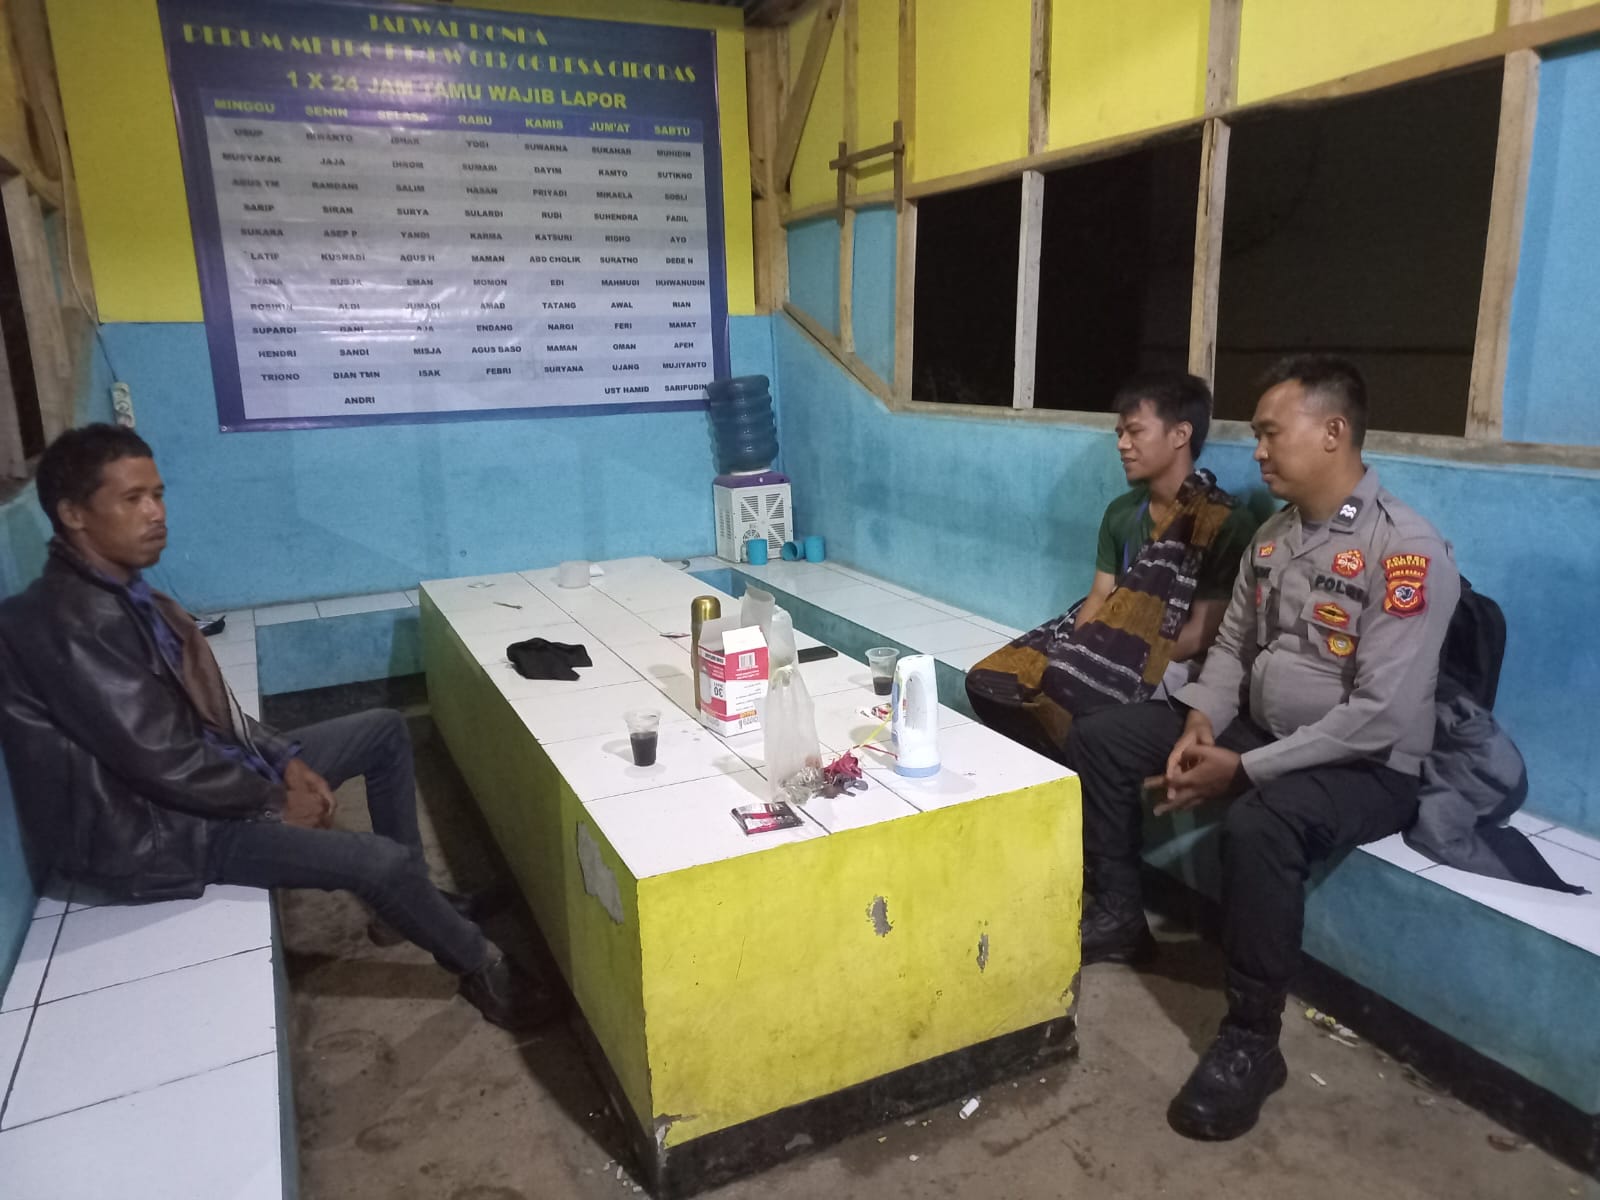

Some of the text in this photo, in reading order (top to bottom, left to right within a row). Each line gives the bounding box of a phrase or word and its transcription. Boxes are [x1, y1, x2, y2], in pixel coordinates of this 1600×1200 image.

[367, 13, 549, 46] JADWAL RONDA
[183, 24, 284, 51] PERUM
[549, 55, 604, 77] DESA
[287, 70, 627, 109] 1 X 24 JAM TAMU WAJIB LAPOR
[214, 99, 276, 113] MINGGU
[305, 105, 348, 118] SENIN
[458, 114, 492, 126] RABU
[525, 118, 564, 129] KAMIS
[590, 122, 631, 134] JUM'AT
[654, 125, 690, 137] SABTU
[524, 143, 568, 153] SUWARNA
[320, 157, 346, 167] JAJA
[657, 171, 693, 180] SUTIKNO
[396, 207, 430, 217] SURYA
[594, 213, 639, 222] SUHENDRA
[323, 230, 350, 238] ASEP
[400, 254, 427, 263] AGUS
[471, 255, 506, 263] MAMAN
[600, 257, 639, 265] SURATNO
[406, 279, 435, 287] EMAN
[473, 279, 509, 287] MOMON
[550, 279, 565, 287] EDI
[601, 279, 640, 287] MAHMUDI
[405, 302, 441, 310] JUMADI
[542, 302, 577, 310] TATANG
[672, 301, 692, 309] RIAN
[476, 324, 514, 333] ENDANG
[614, 322, 632, 330] FERI
[669, 321, 697, 329] MAMAT
[252, 326, 297, 335] SUPARDI
[413, 347, 442, 355] MISJA
[471, 346, 496, 354] AGUS
[546, 344, 578, 352] MAMAN
[612, 343, 637, 351] OMAN
[258, 350, 297, 358] HENDRI
[339, 348, 369, 357] SANDI
[544, 365, 584, 373] SURYANA
[612, 363, 640, 371] UJANG
[662, 361, 707, 369] MUJIYANTO
[418, 369, 441, 377] ISAK
[485, 367, 512, 375] FEBRI
[261, 373, 300, 381] TRIONO
[333, 371, 357, 380] DIAN
[604, 385, 650, 394] UST HAMID
[344, 396, 375, 405] ANDRI
